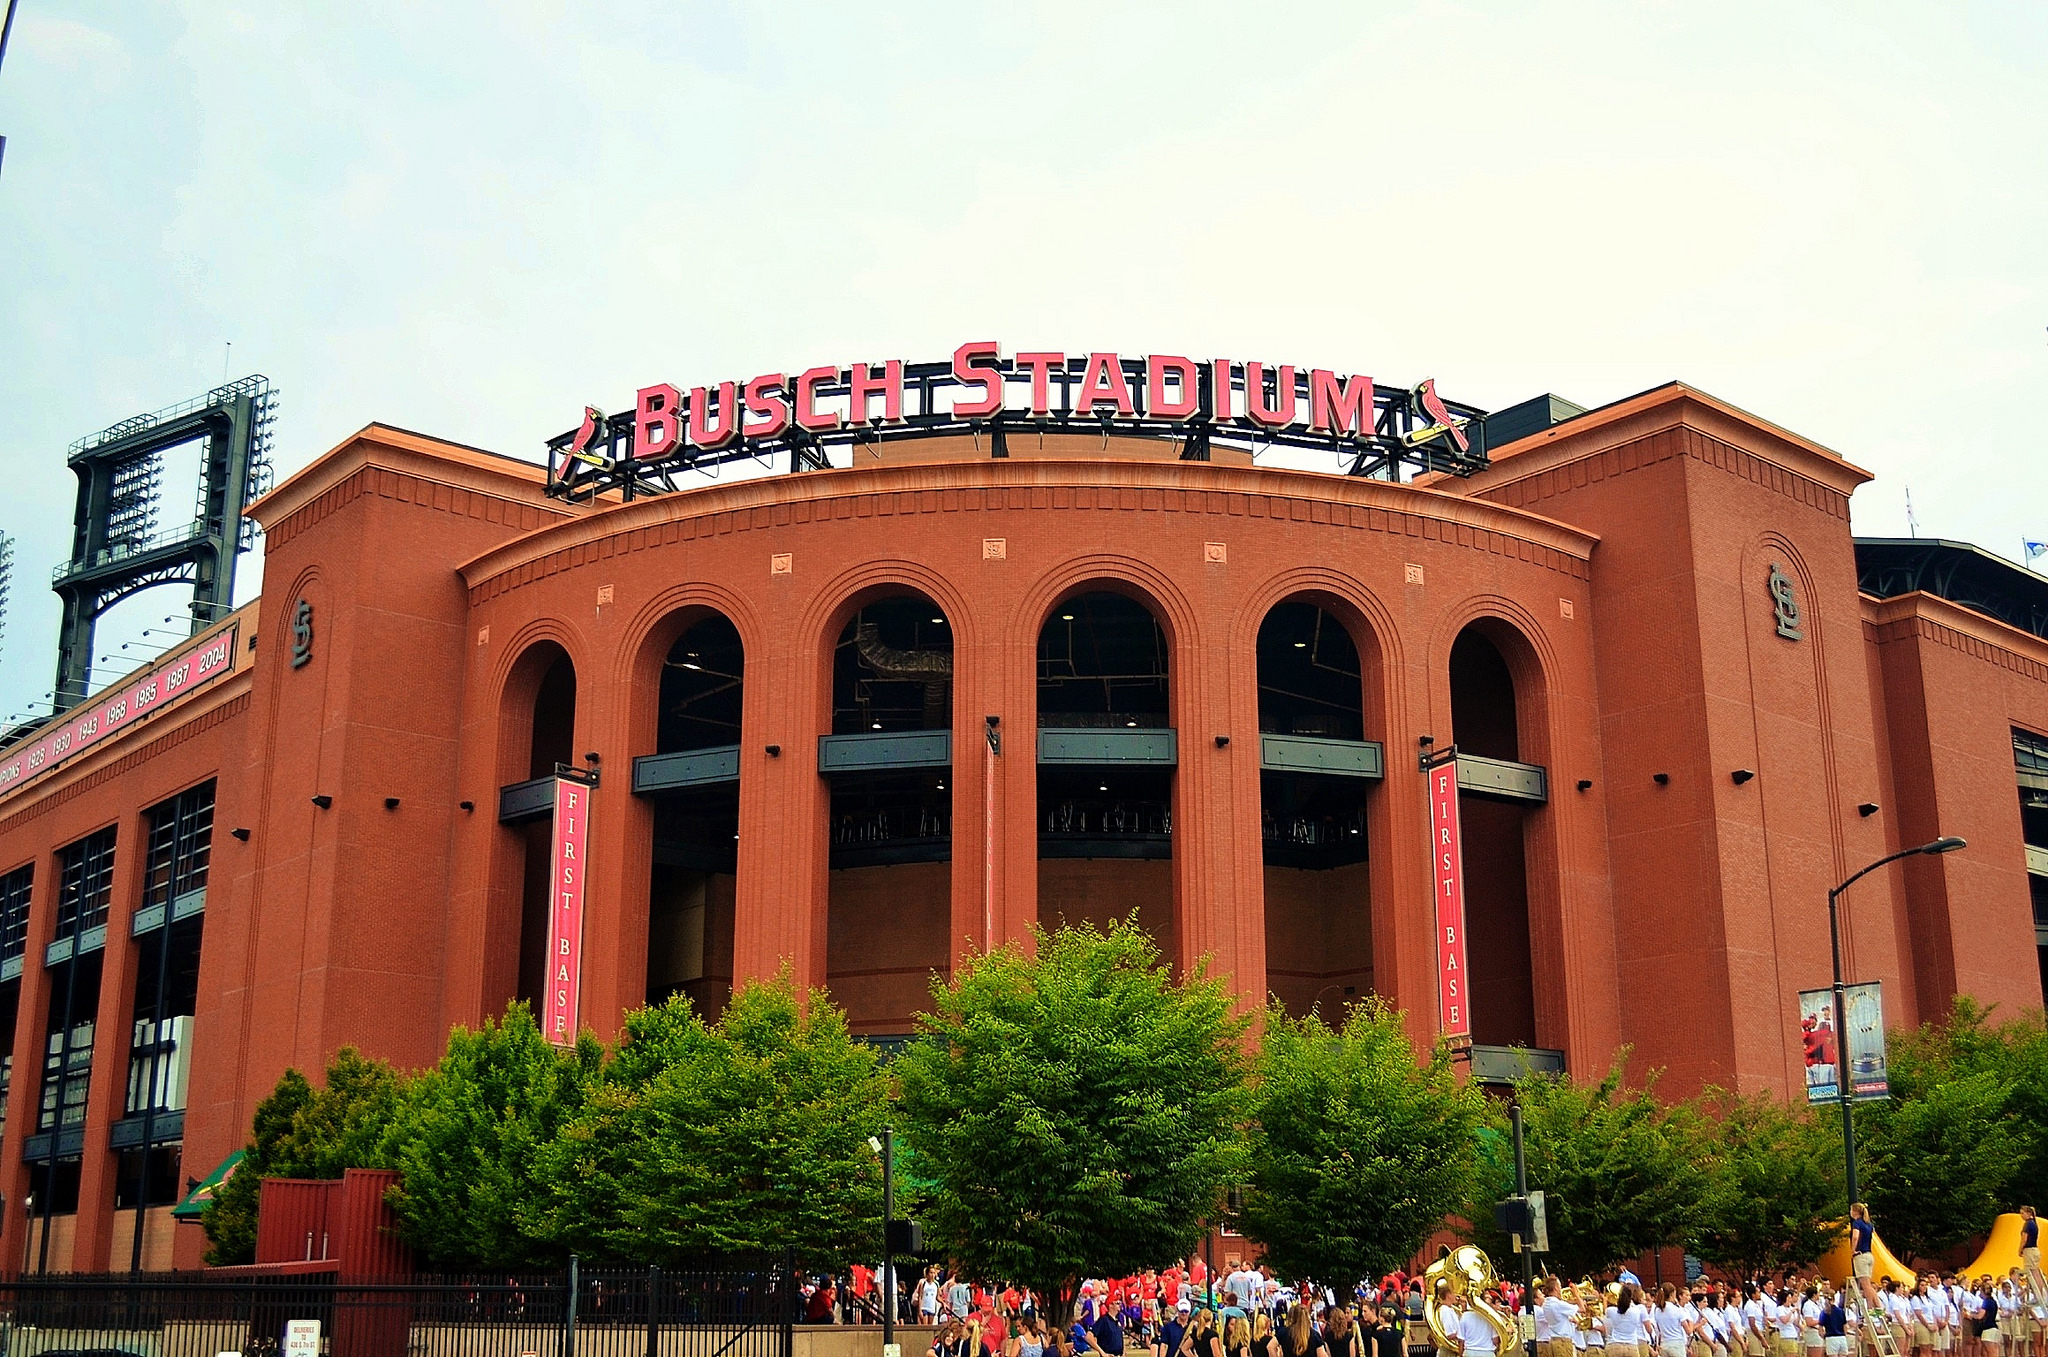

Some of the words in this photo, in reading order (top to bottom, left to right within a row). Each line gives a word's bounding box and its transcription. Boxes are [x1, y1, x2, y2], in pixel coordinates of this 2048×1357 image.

[632, 358, 908, 462] BUSCH
[951, 340, 1378, 441] STADIUM
[28, 747, 46, 770] 1928
[52, 731, 71, 756] 1930
[78, 716, 98, 741] 1943
[106, 700, 127, 726] 1968
[135, 682, 157, 709] 1985
[166, 663, 190, 692] 1987
[199, 643, 225, 674] 2004
[562, 792, 578, 910] FIRST
[1439, 775, 1454, 897] FIRST
[555, 938, 571, 1033] BASE
[1446, 926, 1460, 1024] BASE
